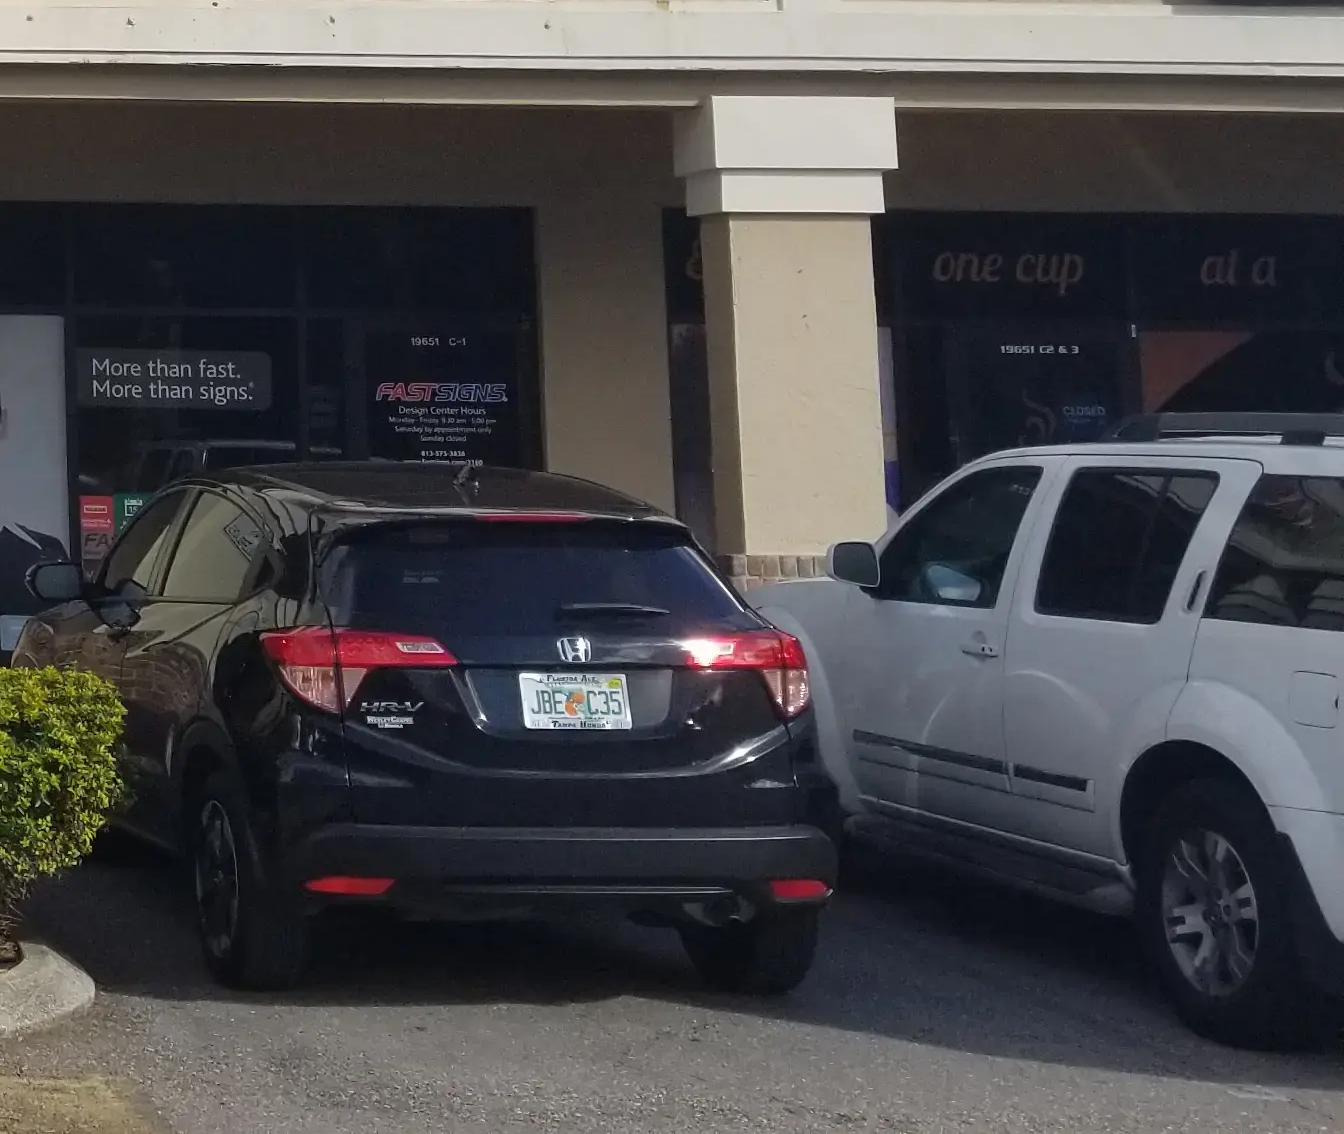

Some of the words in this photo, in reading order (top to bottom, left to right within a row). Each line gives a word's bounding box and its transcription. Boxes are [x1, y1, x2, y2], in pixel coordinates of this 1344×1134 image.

[931, 251, 1003, 285] one
[1014, 251, 1084, 296] cup
[1200, 247, 1238, 287] at
[1251, 254, 1278, 287] a
[410, 337, 440, 346] 19651
[448, 337, 467, 346] C-1
[1000, 345, 1035, 354] 19651
[92, 358, 141, 377] More
[148, 359, 192, 378] than
[199, 359, 241, 379] fast.
[93, 379, 143, 398] More
[149, 380, 193, 399] than
[376, 382, 507, 402] FASTSIGNS
[398, 406, 429, 416] Design
[430, 406, 459, 415] Center
[461, 406, 487, 415] Hours
[360, 701, 425, 712] HR-V
[531, 690, 566, 715] JBE
[586, 691, 623, 715] C35
